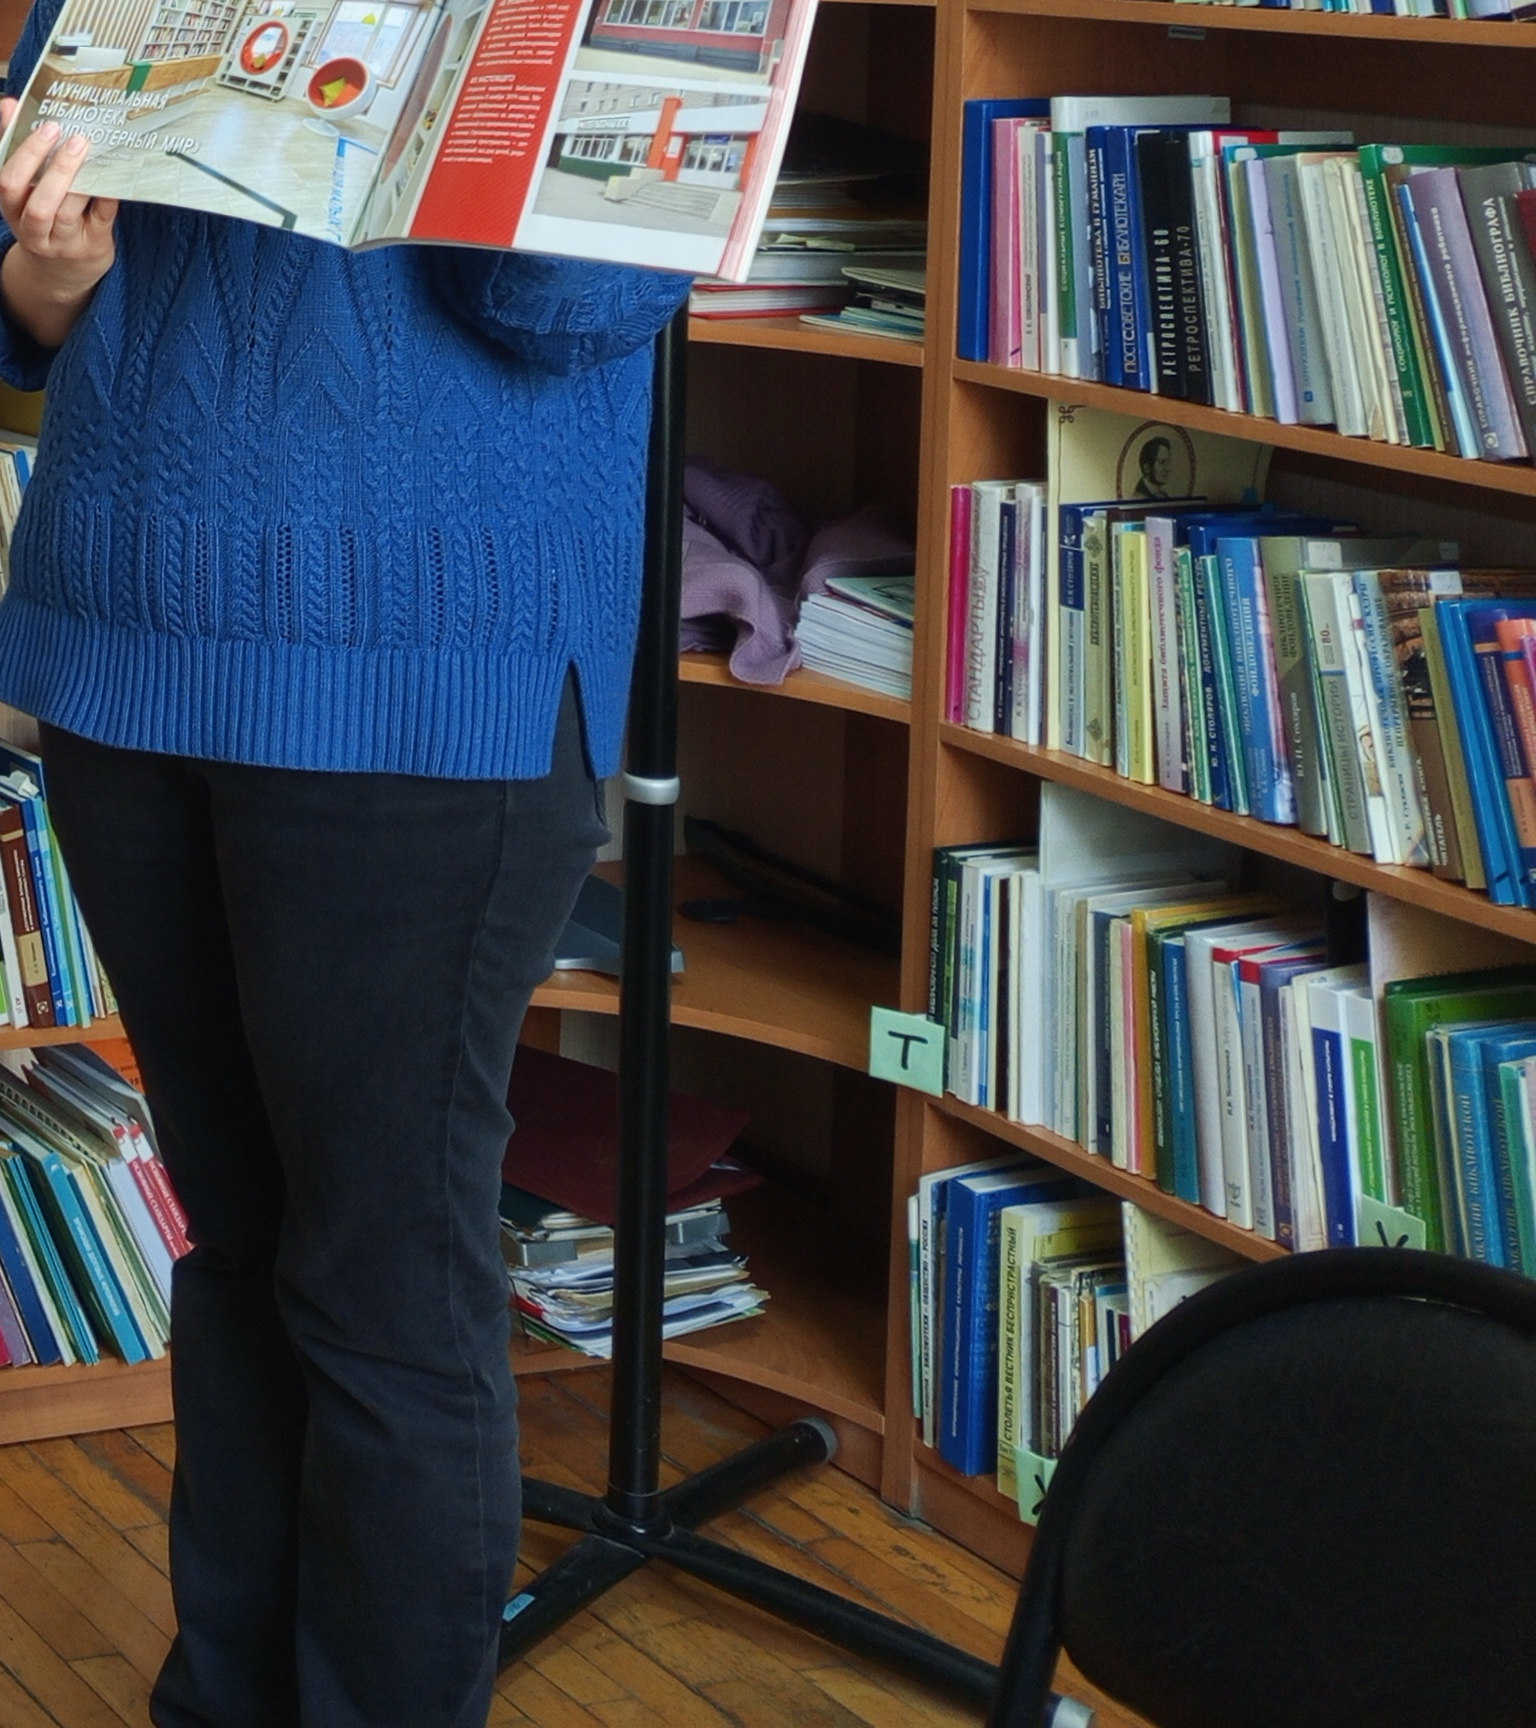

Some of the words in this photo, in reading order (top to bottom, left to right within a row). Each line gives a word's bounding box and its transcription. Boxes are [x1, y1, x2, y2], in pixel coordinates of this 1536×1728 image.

[38, 100, 128, 126] БИБЛИОТЕКА
[46, 80, 170, 110] МУНИЦИПАЛЬНАЯ
[1364, 177, 1385, 240] БИБЛИОТЕКЕ
[1375, 241, 1386, 250] В
[1482, 196, 1516, 303] БИБЛИОГРАФА
[1377, 253, 1396, 304] ПСИХОЛОГ
[1387, 306, 1398, 315] И
[1389, 318, 1408, 372] СОЦИОЛОГ
[1505, 306, 1536, 405] СПРАВОЧНИК
[888, 1031, 928, 1070] Т
[1005, 1226, 1017, 1333] БЕСПРИСТРАСТНЫЙ
[1004, 1335, 1015, 1383] ВЕСТНИК
[1002, 1385, 1013, 1440] СТОЛЕТЬЯ
